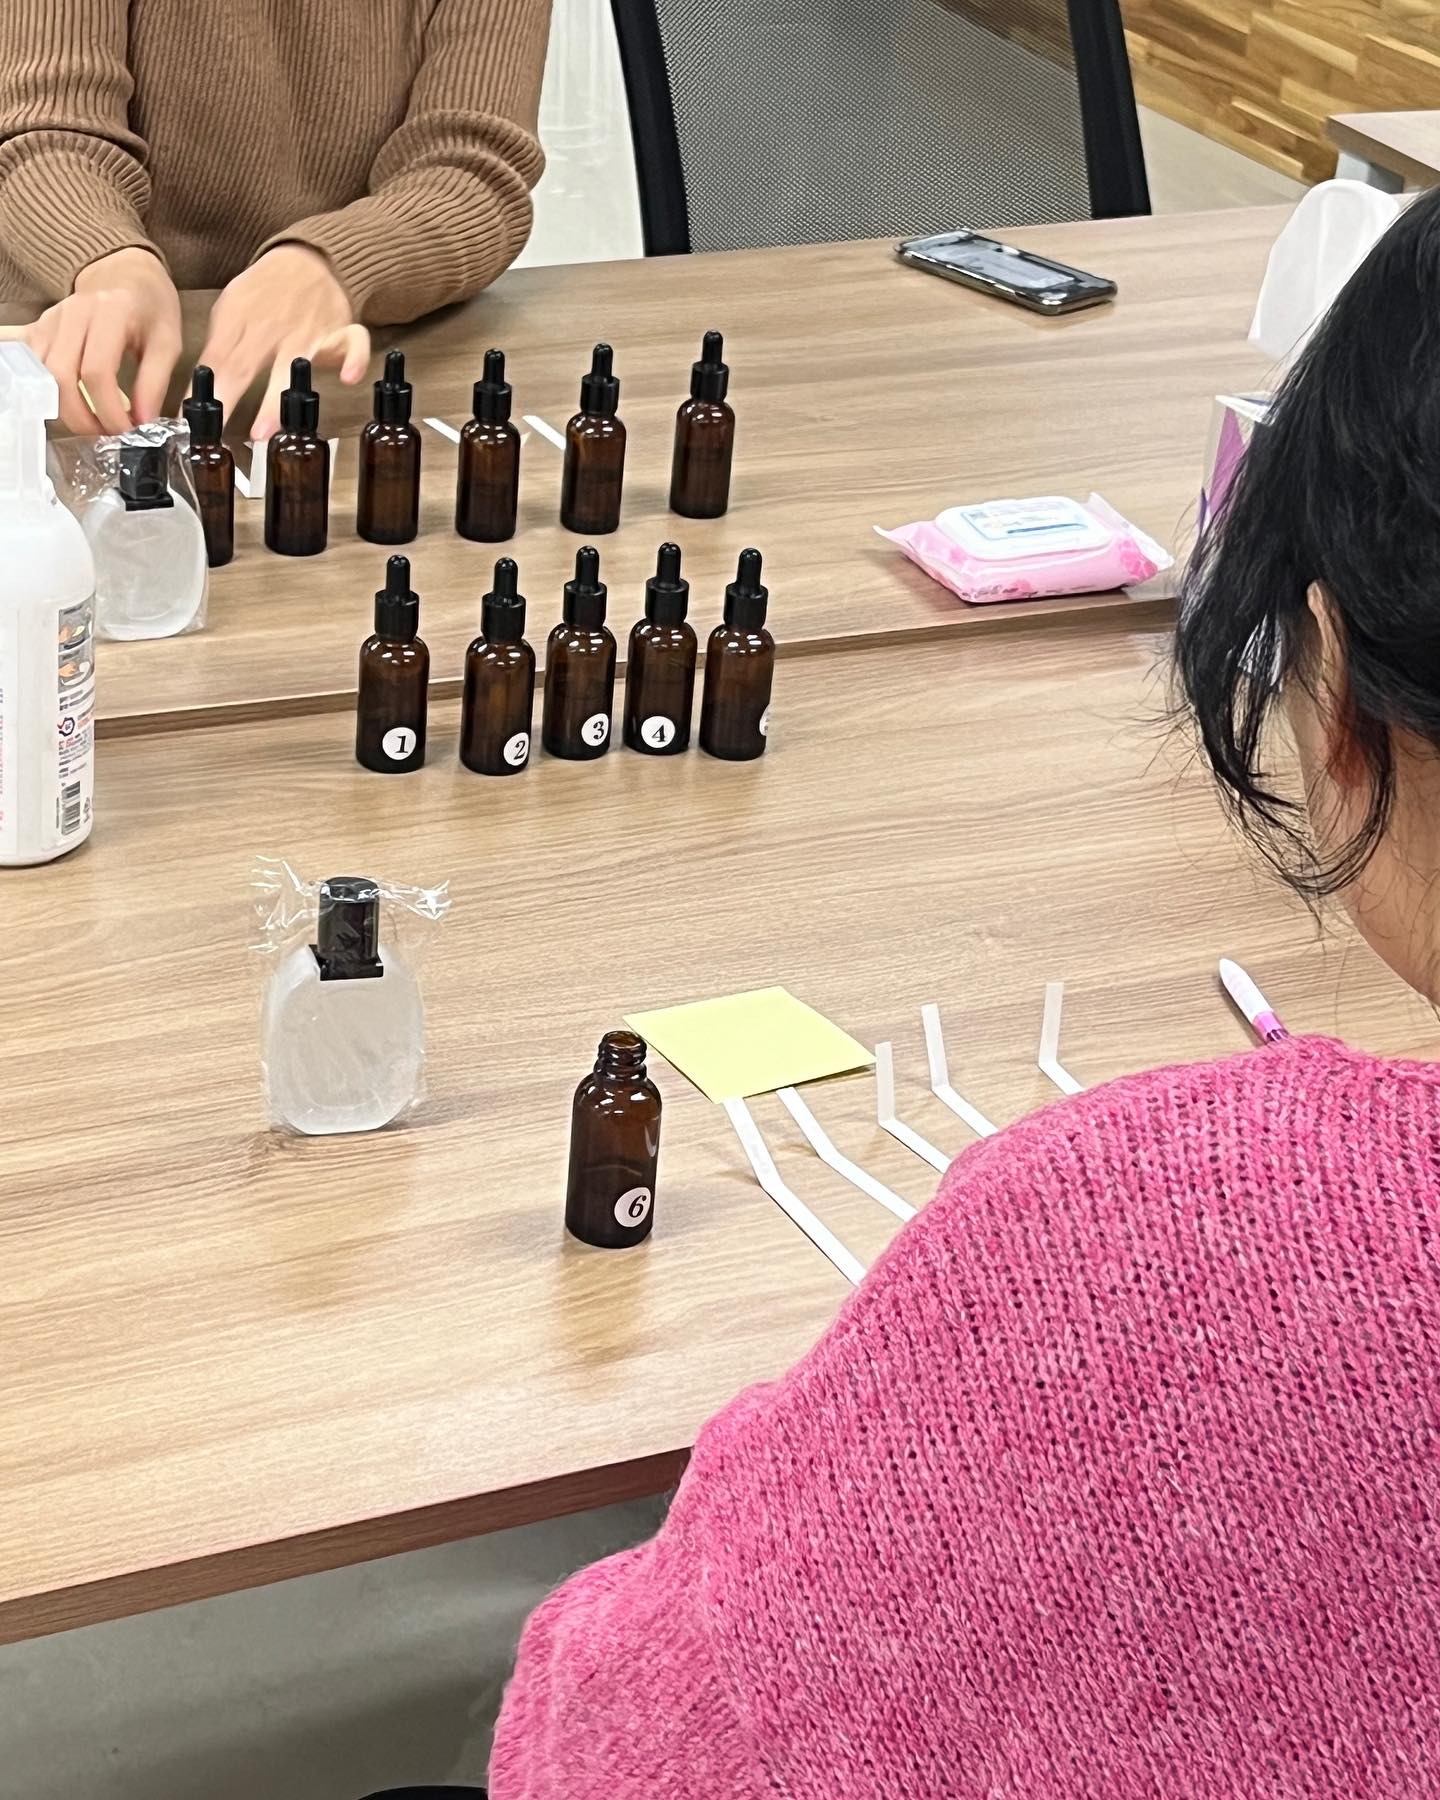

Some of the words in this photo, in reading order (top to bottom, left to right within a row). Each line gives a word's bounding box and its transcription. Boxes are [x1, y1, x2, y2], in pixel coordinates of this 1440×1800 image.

[593, 721, 604, 740] 3
[651, 724, 666, 743] 4
[395, 735, 409, 754] 1
[513, 740, 526, 760] 2
[628, 1194, 647, 1219] 6
